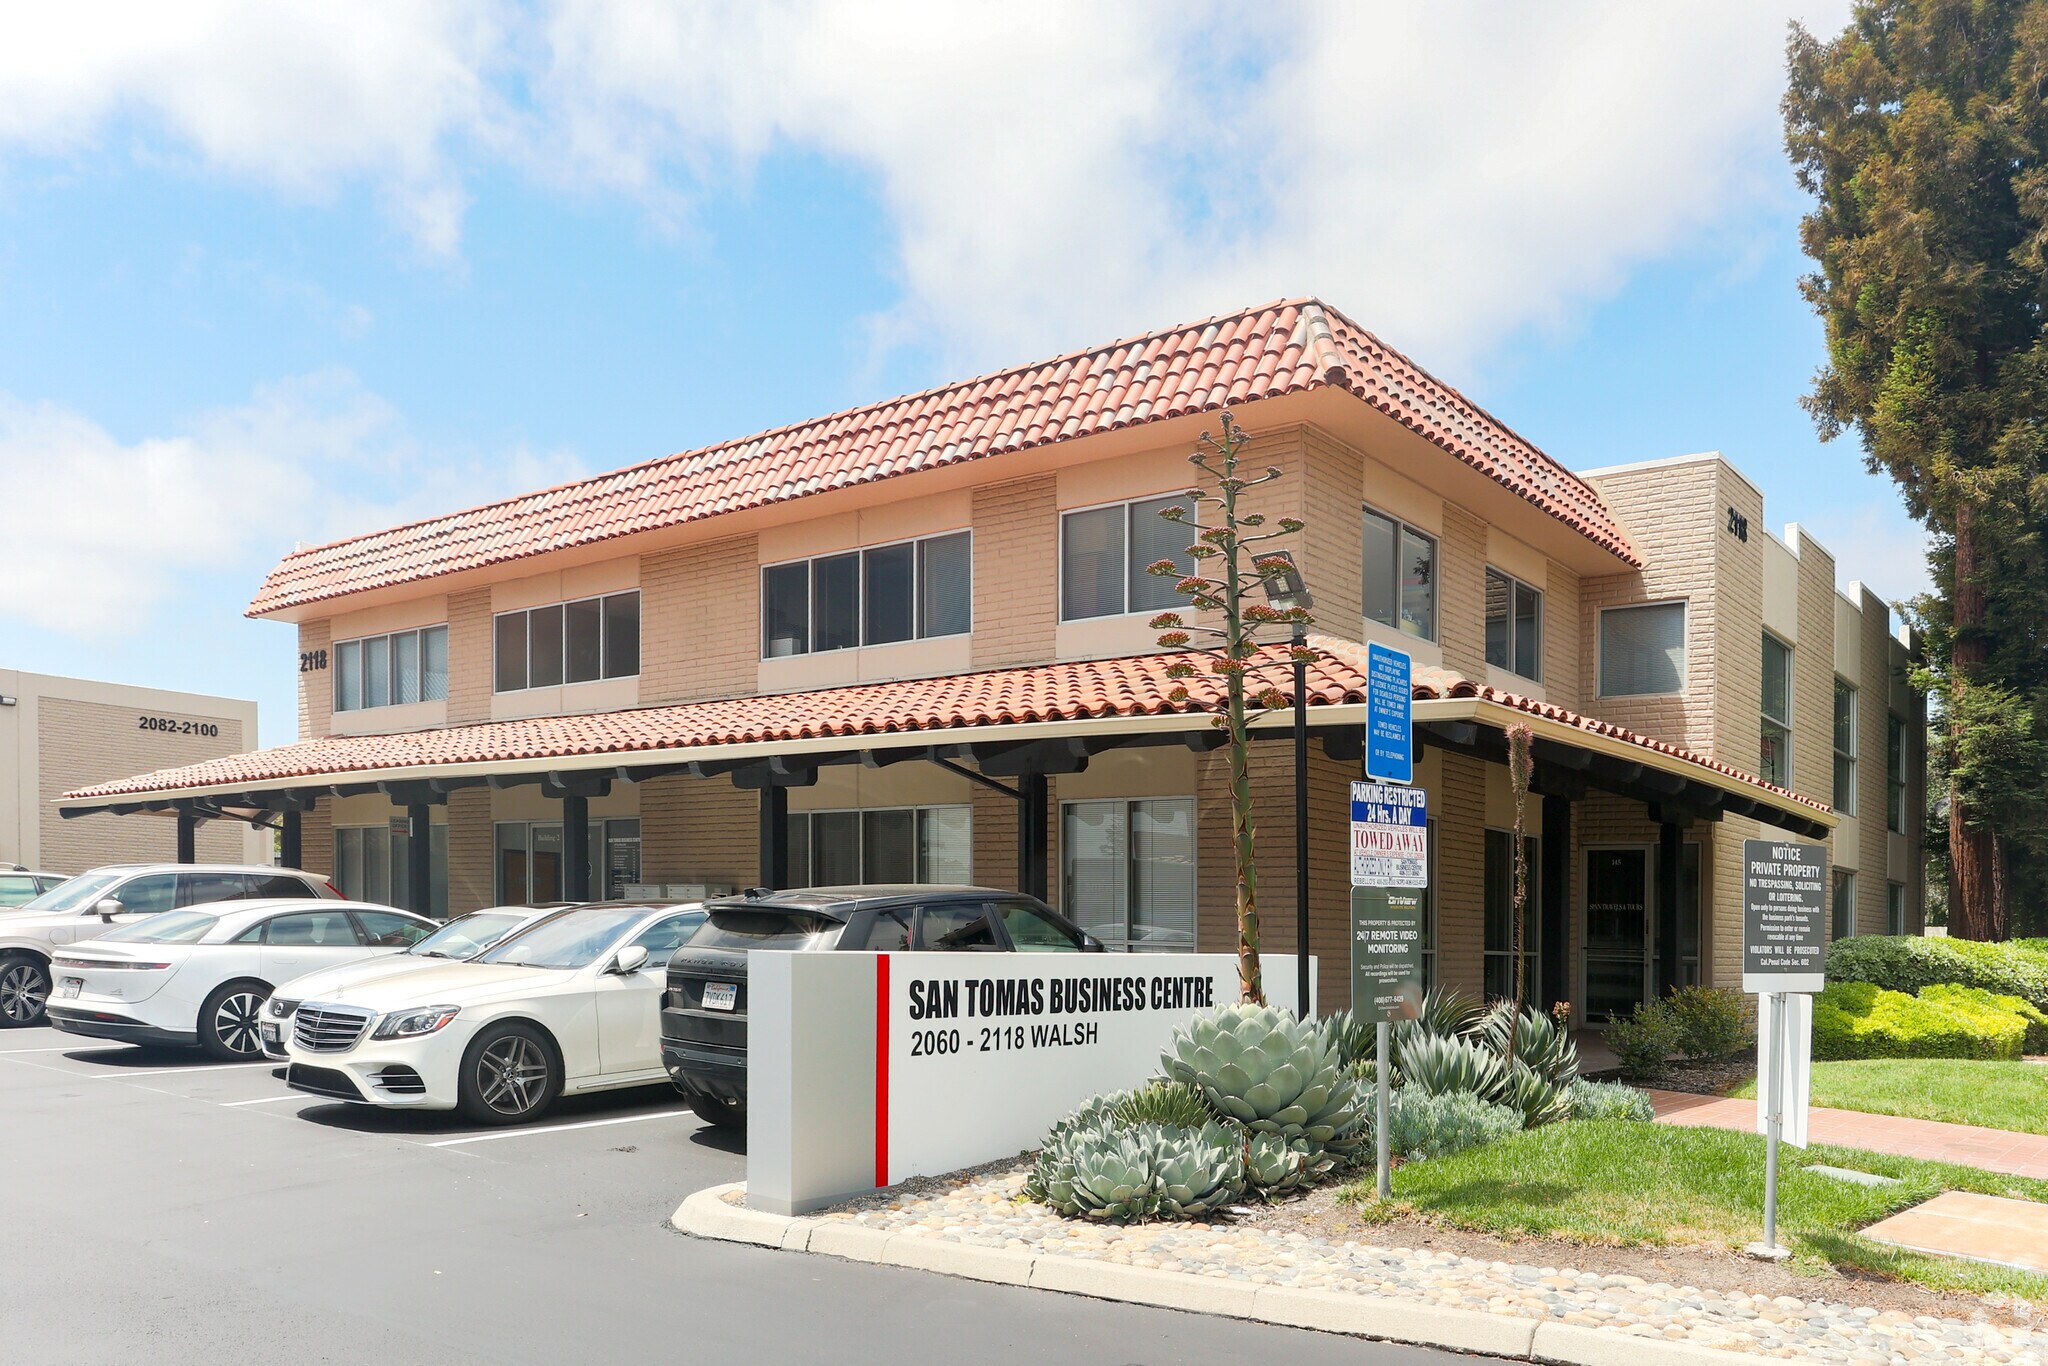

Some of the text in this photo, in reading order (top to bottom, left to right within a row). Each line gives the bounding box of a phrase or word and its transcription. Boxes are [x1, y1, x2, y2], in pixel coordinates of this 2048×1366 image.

[300, 650, 326, 672] 2118
[1394, 660, 1406, 670] VEHICLES
[1387, 684, 1398, 692] PLATES
[1387, 700, 1396, 709] TOWED
[139, 716, 218, 737] 2082-2100
[1378, 721, 1402, 732] TOWED VEHICLES
[1352, 783, 1425, 808] PARKING RESTRICTED
[1367, 804, 1412, 825] 24 Hrs. A DAY
[1354, 822, 1387, 830] UNAUTHORIZED
[1354, 830, 1424, 852] TOWED AWAY
[1772, 846, 1801, 860] NOTICE
[1751, 862, 1820, 878] PRIVATE PROPERTY
[1750, 878, 1822, 891] NO TRESPASSING, SOLICITING
[1769, 892, 1803, 902] OR LOITERING.
[1751, 903, 1760, 912] Open
[1788, 905, 1797, 913] doing
[1760, 924, 1779, 932] Permission
[1371, 931, 1398, 940] REMOTE
[1400, 931, 1418, 940] VIDEO
[1368, 944, 1408, 953] MONITORING
[1750, 946, 1820, 954] VIOLATORS WILL BE PROSECUTED
[909, 976, 1213, 1020] SAN TOMAS BUSINESS CENTRE
[911, 1029, 960, 1057] 2060
[980, 1026, 1024, 1052] 2118
[1031, 1022, 1098, 1048] WALSH
